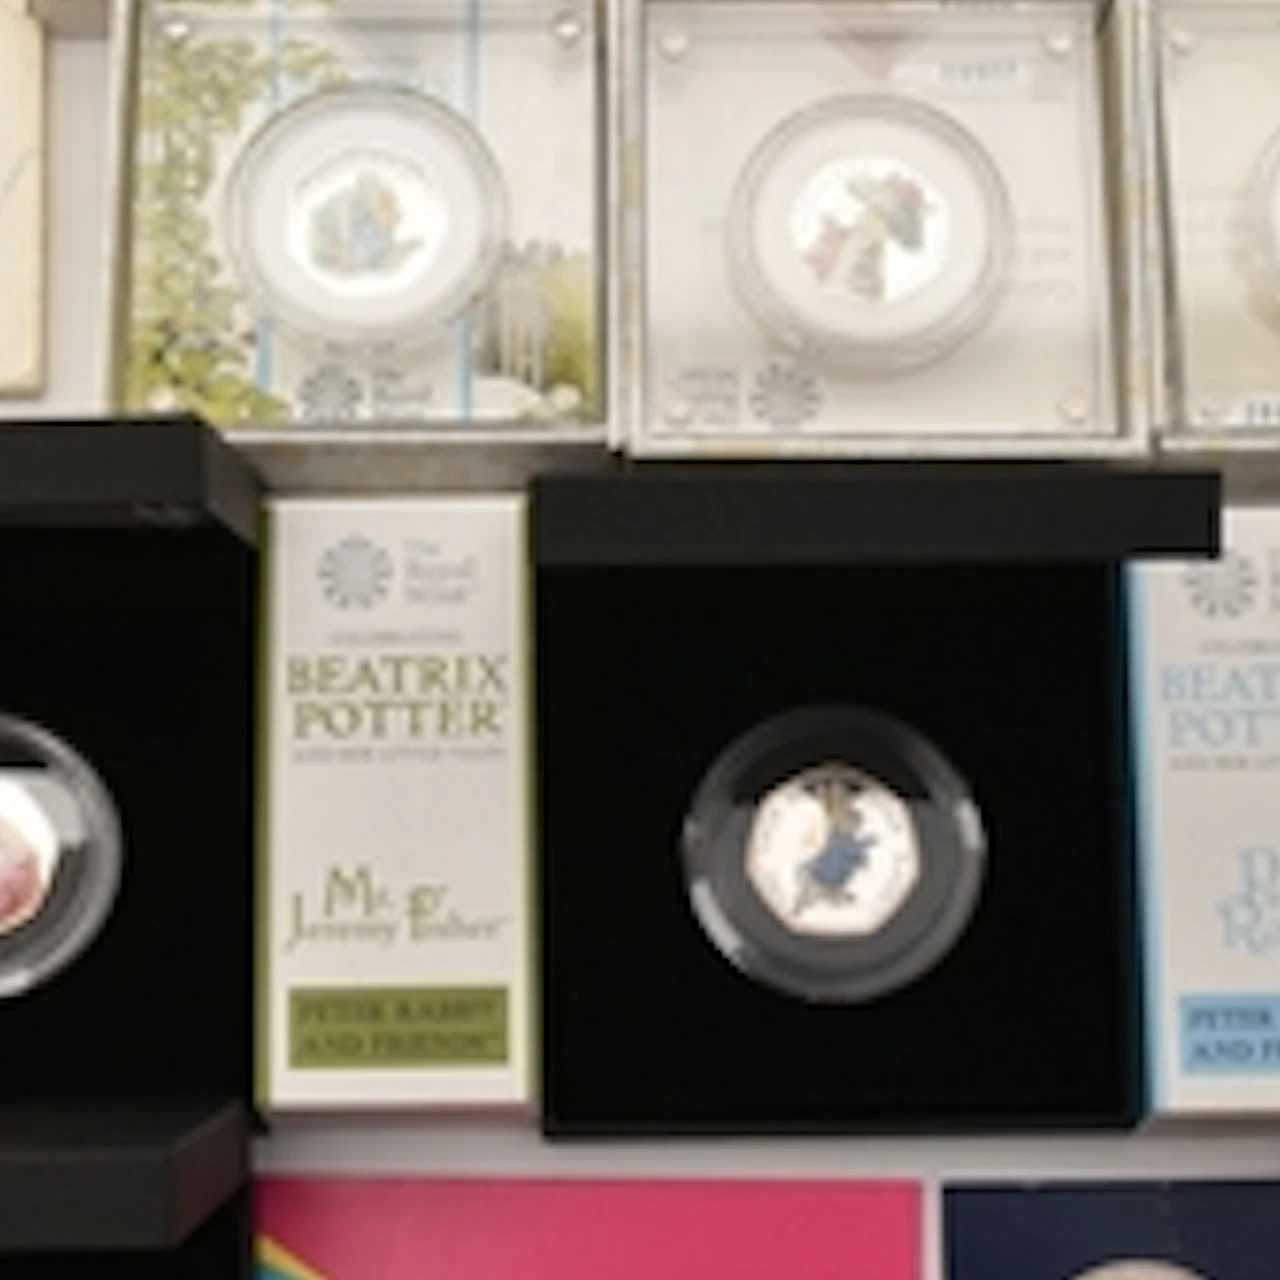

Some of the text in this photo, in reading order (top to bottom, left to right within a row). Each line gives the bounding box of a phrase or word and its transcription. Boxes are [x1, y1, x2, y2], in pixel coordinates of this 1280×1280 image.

[286, 654, 508, 696] BEATRIX
[293, 700, 504, 740] POTTER
[1188, 1006, 1272, 1031] PETER
[1191, 1039, 1256, 1063] AND
